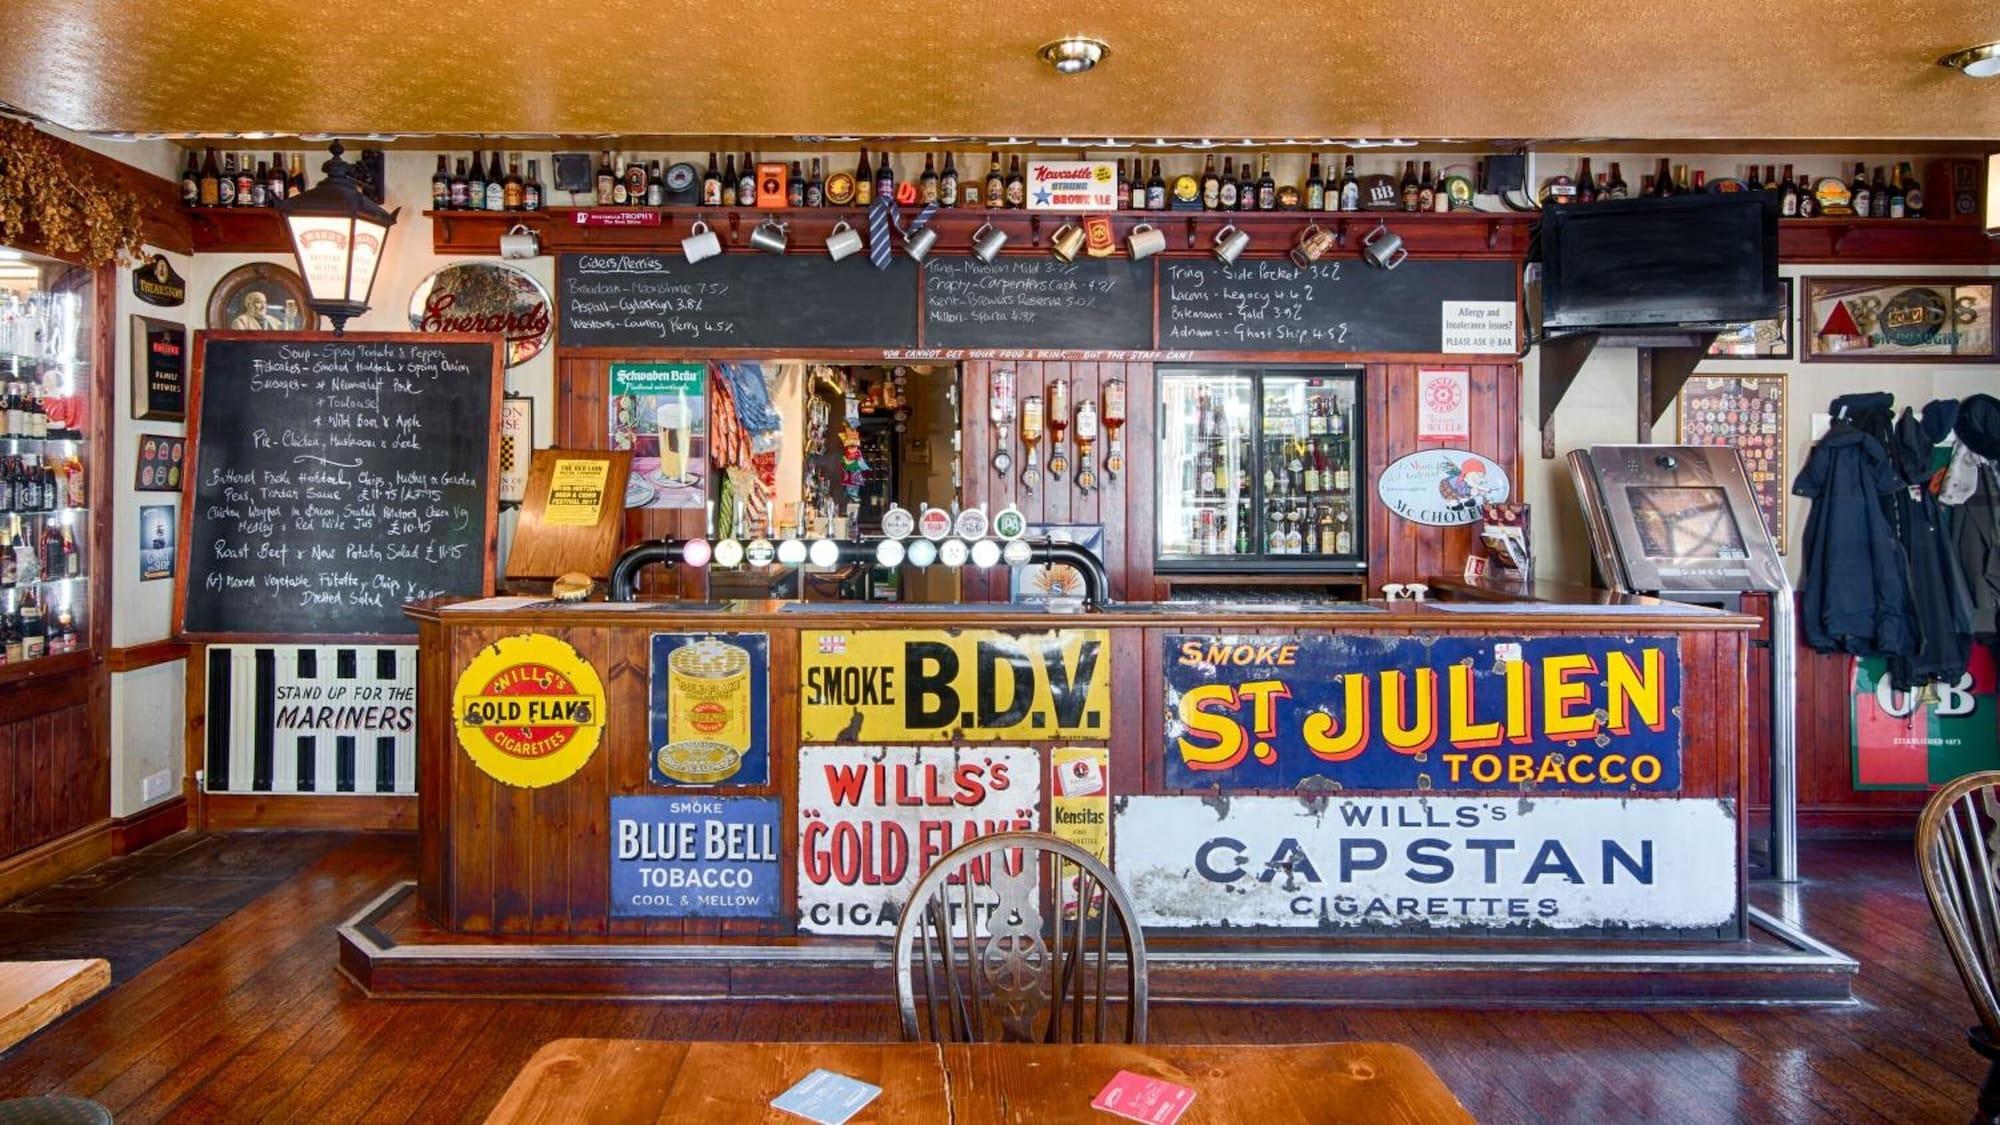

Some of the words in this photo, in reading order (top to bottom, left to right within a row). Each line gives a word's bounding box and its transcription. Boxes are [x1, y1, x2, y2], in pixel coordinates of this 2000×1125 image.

[1034, 165, 1092, 182] Newcastle
[1051, 182, 1088, 190] STRONG
[620, 212, 653, 220] TROPHY
[1169, 266, 1205, 287] Tring
[1224, 267, 1254, 281] Side
[1259, 261, 1301, 281] Pocket
[1171, 286, 1210, 302] Lacons
[1224, 286, 1271, 307] Legacy
[420, 287, 550, 335] Everards
[1458, 307, 1485, 318] Allergy
[1487, 307, 1501, 317] and
[624, 317, 667, 338] Country
[1234, 323, 1272, 343] Ghost
[1277, 325, 1308, 343] Ship
[279, 344, 311, 361] Soup
[904, 349, 942, 359] CANNOT
[945, 349, 964, 359] GET
[1083, 350, 1105, 360] BUT
[1107, 350, 1126, 360] THE
[1130, 350, 1161, 361] STAFF
[1178, 641, 1299, 667] SMOKE
[277, 686, 323, 701] STAND
[328, 686, 347, 701] UP
[354, 686, 384, 701] FOR
[388, 686, 415, 701] THE
[807, 666, 895, 706] SMOKE
[904, 641, 1102, 730] B.D.V.
[1303, 647, 1667, 762] JULIEN
[276, 705, 416, 732] MARINERS
[494, 731, 566, 756] CIGARETTES
[1443, 753, 1663, 784] TOBACCO
[670, 803, 724, 814] SMOKE
[1055, 805, 1105, 826] Kensitas
[618, 818, 698, 863] BLUE
[704, 818, 780, 863] BELL
[1194, 836, 1654, 885] CAPSTAN
[639, 867, 754, 889] TOBACCO
[632, 894, 674, 906] COOL
[680, 895, 690, 906] &
[698, 895, 761, 907] MELLOW
[1289, 895, 1560, 918] CIGARETTES
